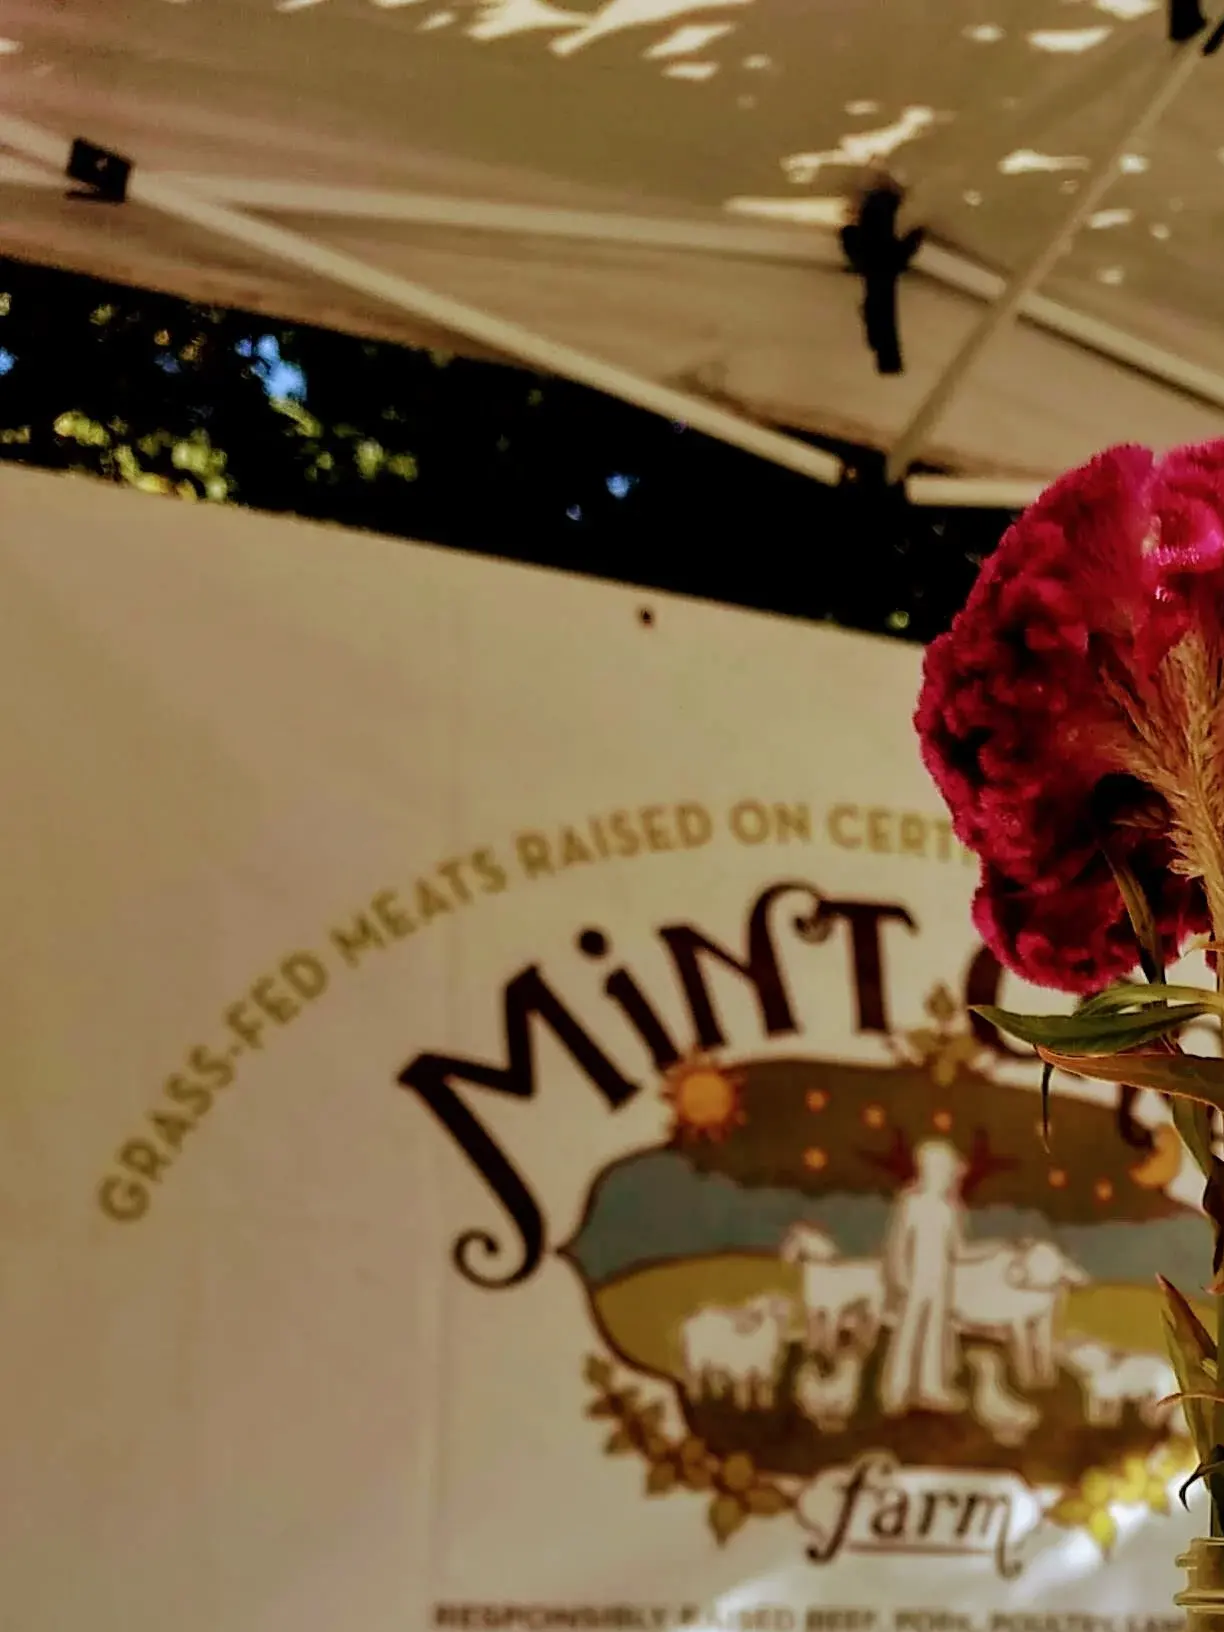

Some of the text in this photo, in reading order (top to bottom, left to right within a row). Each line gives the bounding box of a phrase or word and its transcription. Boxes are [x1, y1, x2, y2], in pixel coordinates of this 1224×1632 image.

[98, 950, 330, 1224] GRASS-FED
[329, 846, 509, 968] MEATS
[514, 800, 714, 880] RAISED
[729, 800, 812, 848] ON
[803, 1460, 1024, 1580] farm
